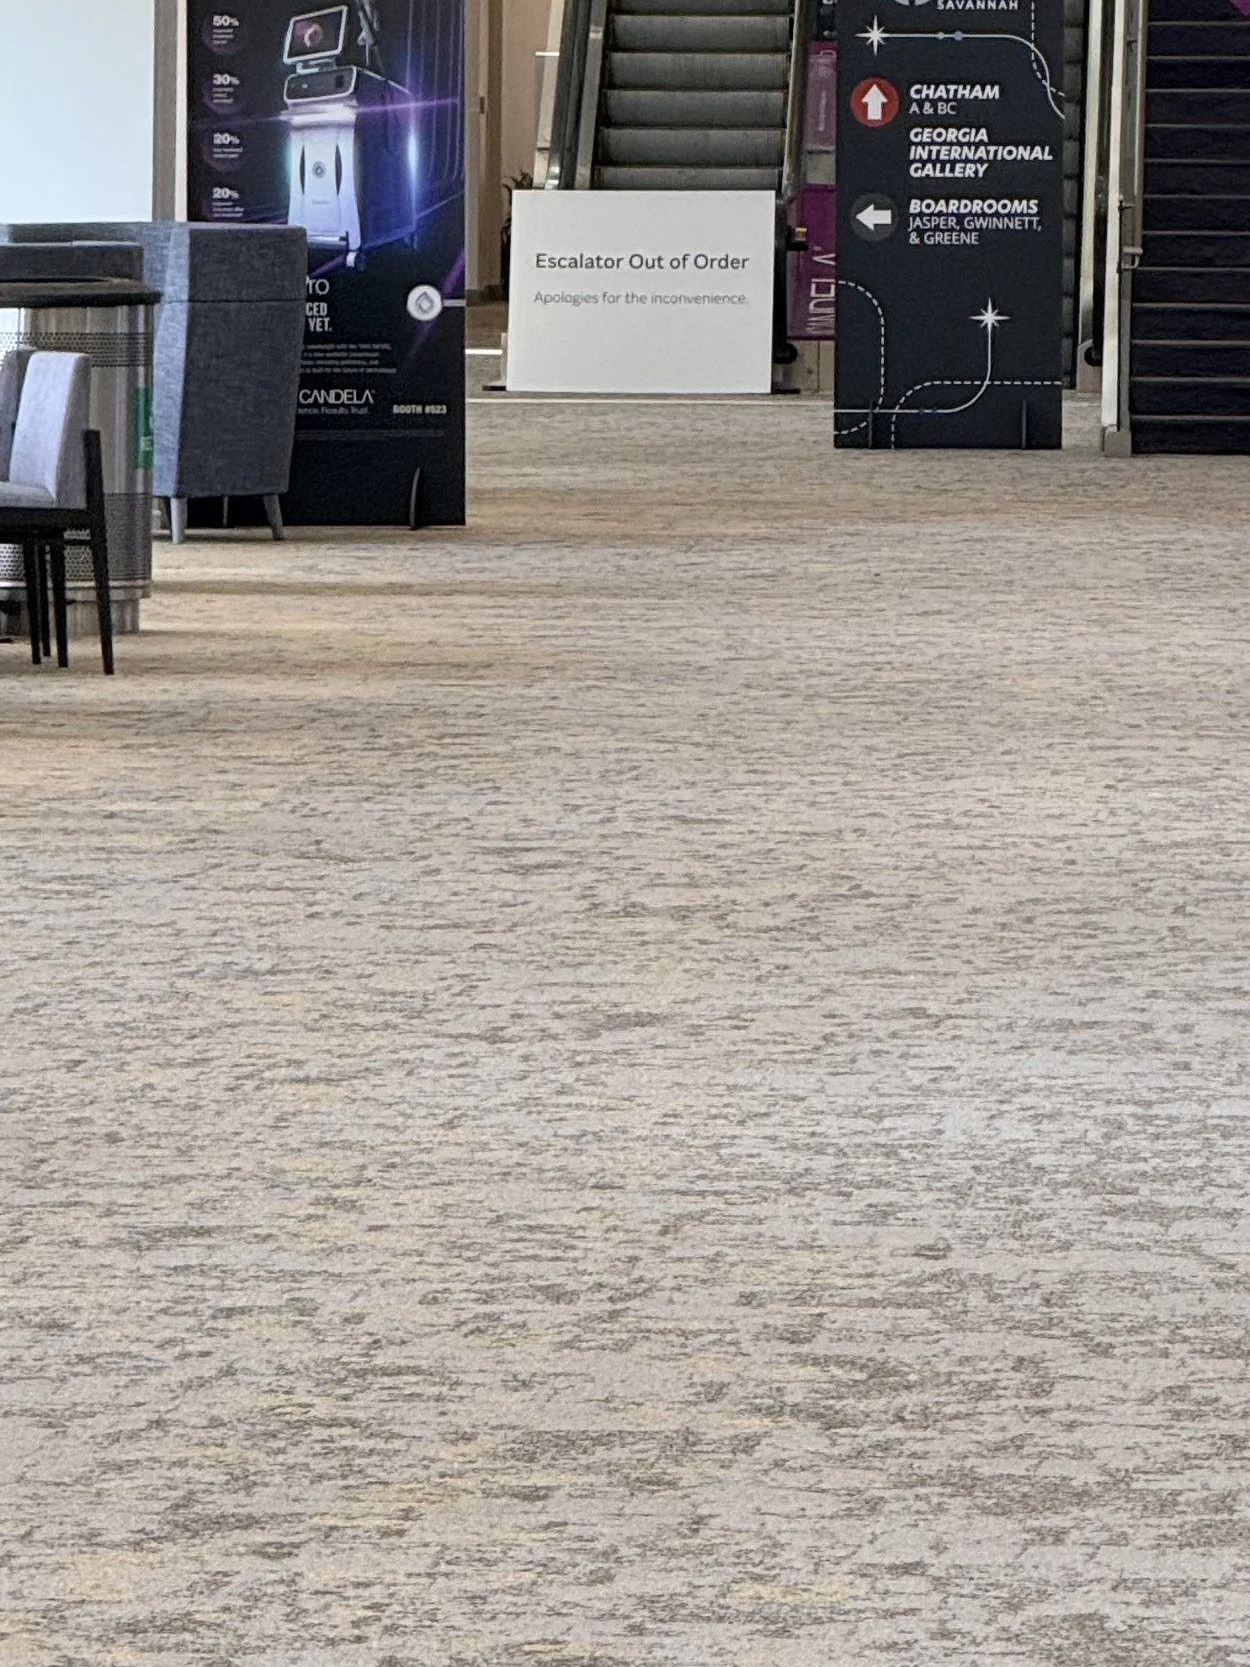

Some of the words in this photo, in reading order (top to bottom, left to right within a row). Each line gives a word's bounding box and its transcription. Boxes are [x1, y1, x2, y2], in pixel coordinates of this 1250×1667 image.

[937, 0, 1019, 10] SAVANNAH
[213, 15, 240, 27] 50%
[213, 74, 240, 85] 30%
[909, 84, 1000, 100] CHATHAM
[909, 102, 921, 115] A
[923, 102, 934, 115] &
[938, 102, 957, 115] BC
[909, 128, 989, 143] GEORGIA
[909, 145, 1054, 161] INTERNATIONAL
[909, 163, 989, 178] GALLERY
[908, 199, 1039, 214] BOARDROOMS
[908, 216, 960, 231] JASPER,
[963, 216, 1042, 232] GWINNETT,
[909, 232, 921, 245] &
[923, 232, 980, 245] GREENE
[535, 253, 625, 270] Escalator
[628, 253, 664, 270] Out
[669, 253, 691, 270] of
[693, 253, 750, 270] Order
[533, 291, 599, 307] Apologies
[602, 291, 622, 305] for
[625, 291, 648, 305] the
[650, 291, 749, 306] inconvenience.
[393, 404, 423, 414] BOOTH
